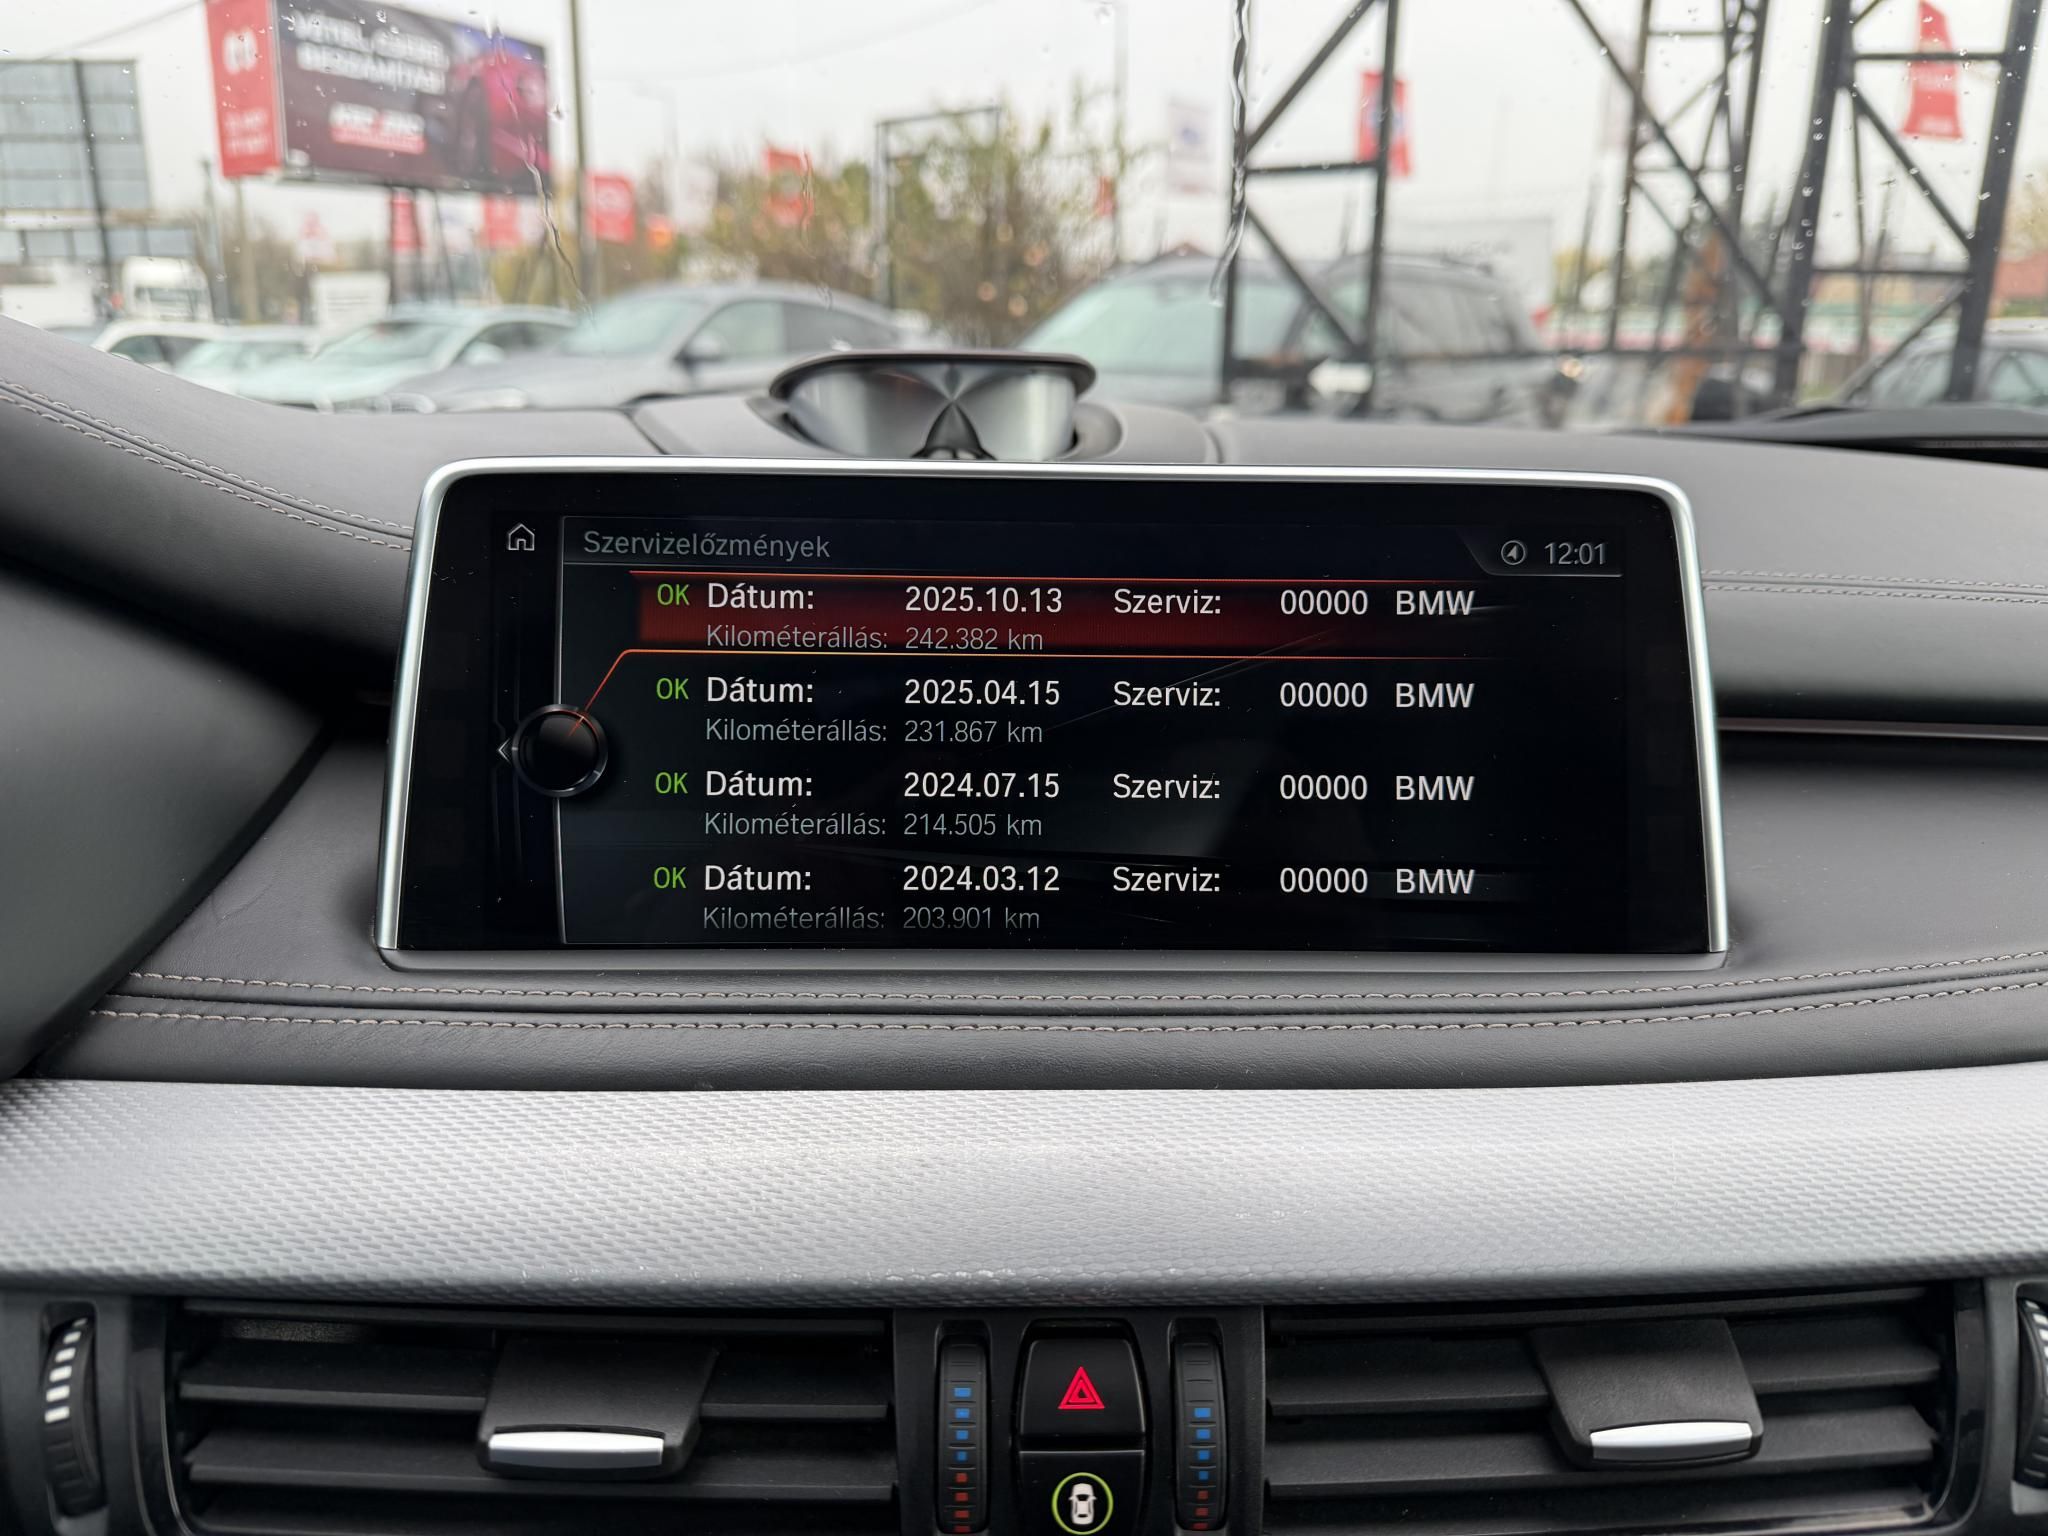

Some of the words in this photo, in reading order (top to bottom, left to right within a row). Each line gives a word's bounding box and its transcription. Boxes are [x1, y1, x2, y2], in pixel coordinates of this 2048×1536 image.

[583, 530, 831, 561] Szervizelőzmények
[1545, 543, 1604, 565] 12:01
[657, 584, 690, 606] OK
[708, 583, 814, 610] Dátum:
[905, 586, 1062, 613] 2025.10.13
[1114, 589, 1221, 615] Szerviz:
[1280, 590, 1369, 615] 00000
[1397, 590, 1475, 615] BMW
[707, 624, 888, 648] Kilométerállás:
[905, 628, 998, 650] 242.382
[1008, 629, 1043, 650] km
[656, 678, 689, 700] OK
[707, 677, 813, 703] Dátum:
[904, 679, 1060, 706] 2025.04.15
[1113, 681, 1221, 707] Szerviz:
[1279, 682, 1368, 708] 00000
[1395, 683, 1475, 708] BMW
[706, 719, 887, 742] Kilométerállás:
[904, 720, 998, 743] 231.867
[1007, 722, 1043, 743] km
[655, 772, 689, 794] OK
[706, 771, 812, 797] Dátum:
[903, 772, 1060, 798] 2024.07.15
[1113, 774, 1220, 799] Szerviz:
[1279, 775, 1368, 801] 00000
[1395, 776, 1475, 801] BMW
[705, 812, 886, 835] Kilométerállás:
[903, 813, 996, 836] 214.505
[1007, 814, 1042, 836] km
[653, 867, 687, 889] OK
[704, 865, 811, 891] Dátum:
[903, 866, 1060, 891] 2024.03.12
[1113, 865, 1220, 892] Szerviz:
[1279, 868, 1368, 894] 00000
[1396, 869, 1475, 895] BMW
[703, 906, 885, 929] Kilométerállás:
[903, 907, 991, 929] 203.901
[1005, 907, 1040, 929] km
